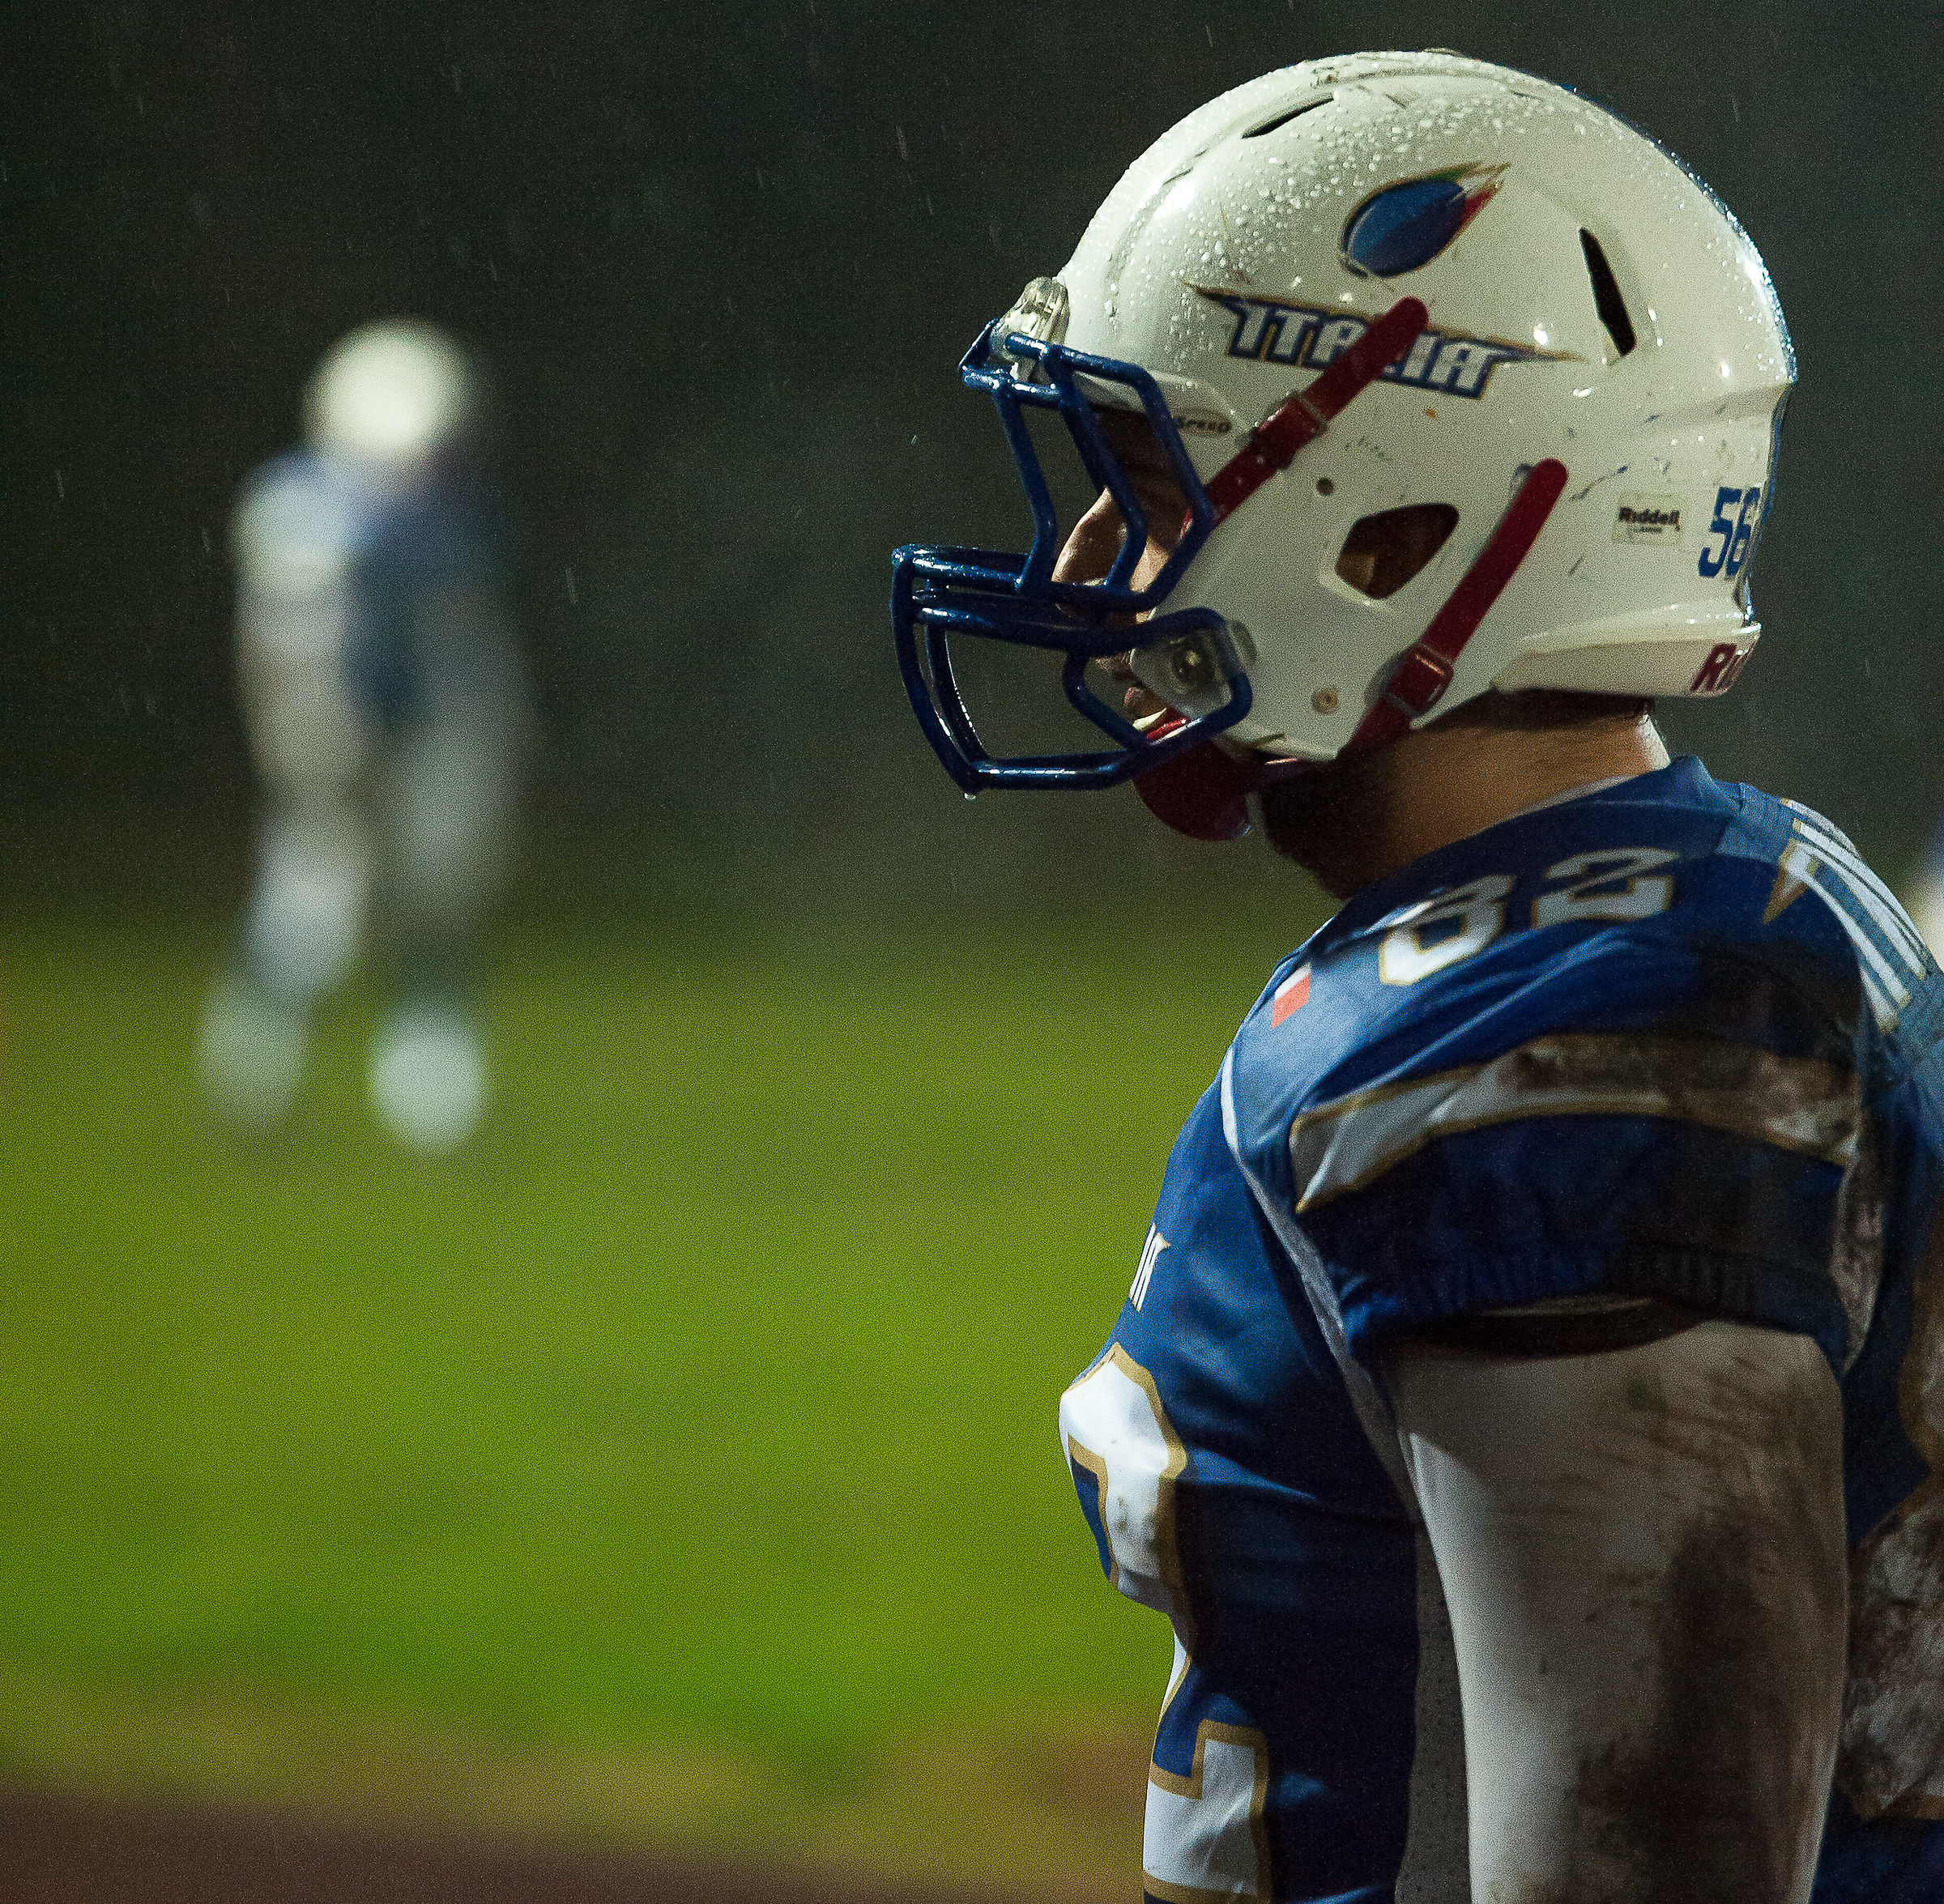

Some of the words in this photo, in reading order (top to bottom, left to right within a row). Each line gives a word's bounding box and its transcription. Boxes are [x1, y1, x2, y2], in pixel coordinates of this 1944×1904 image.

[1225, 298, 1497, 399] ITAIA
[1619, 506, 1680, 526] Riddell
[1698, 486, 1761, 578] 56
[1379, 847, 1679, 987] 82
